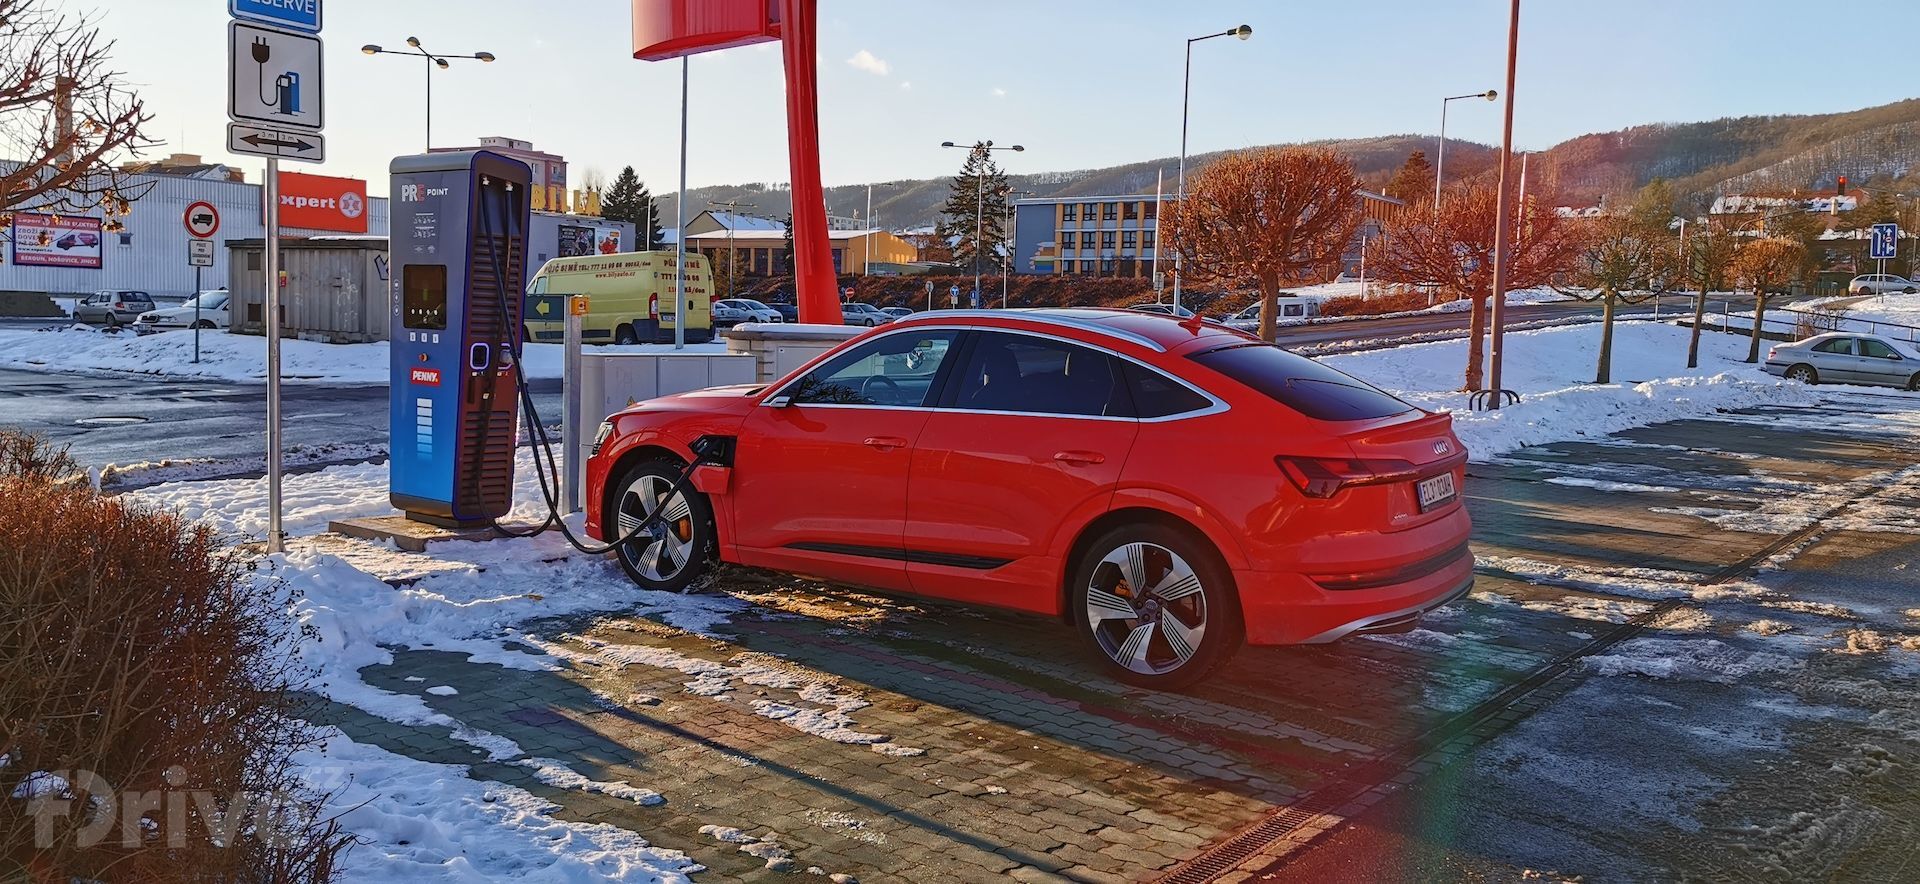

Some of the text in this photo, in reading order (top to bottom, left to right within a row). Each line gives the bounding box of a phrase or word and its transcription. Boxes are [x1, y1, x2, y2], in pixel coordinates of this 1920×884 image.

[401, 184, 449, 202] PRE POINT
[279, 195, 335, 209] xpert
